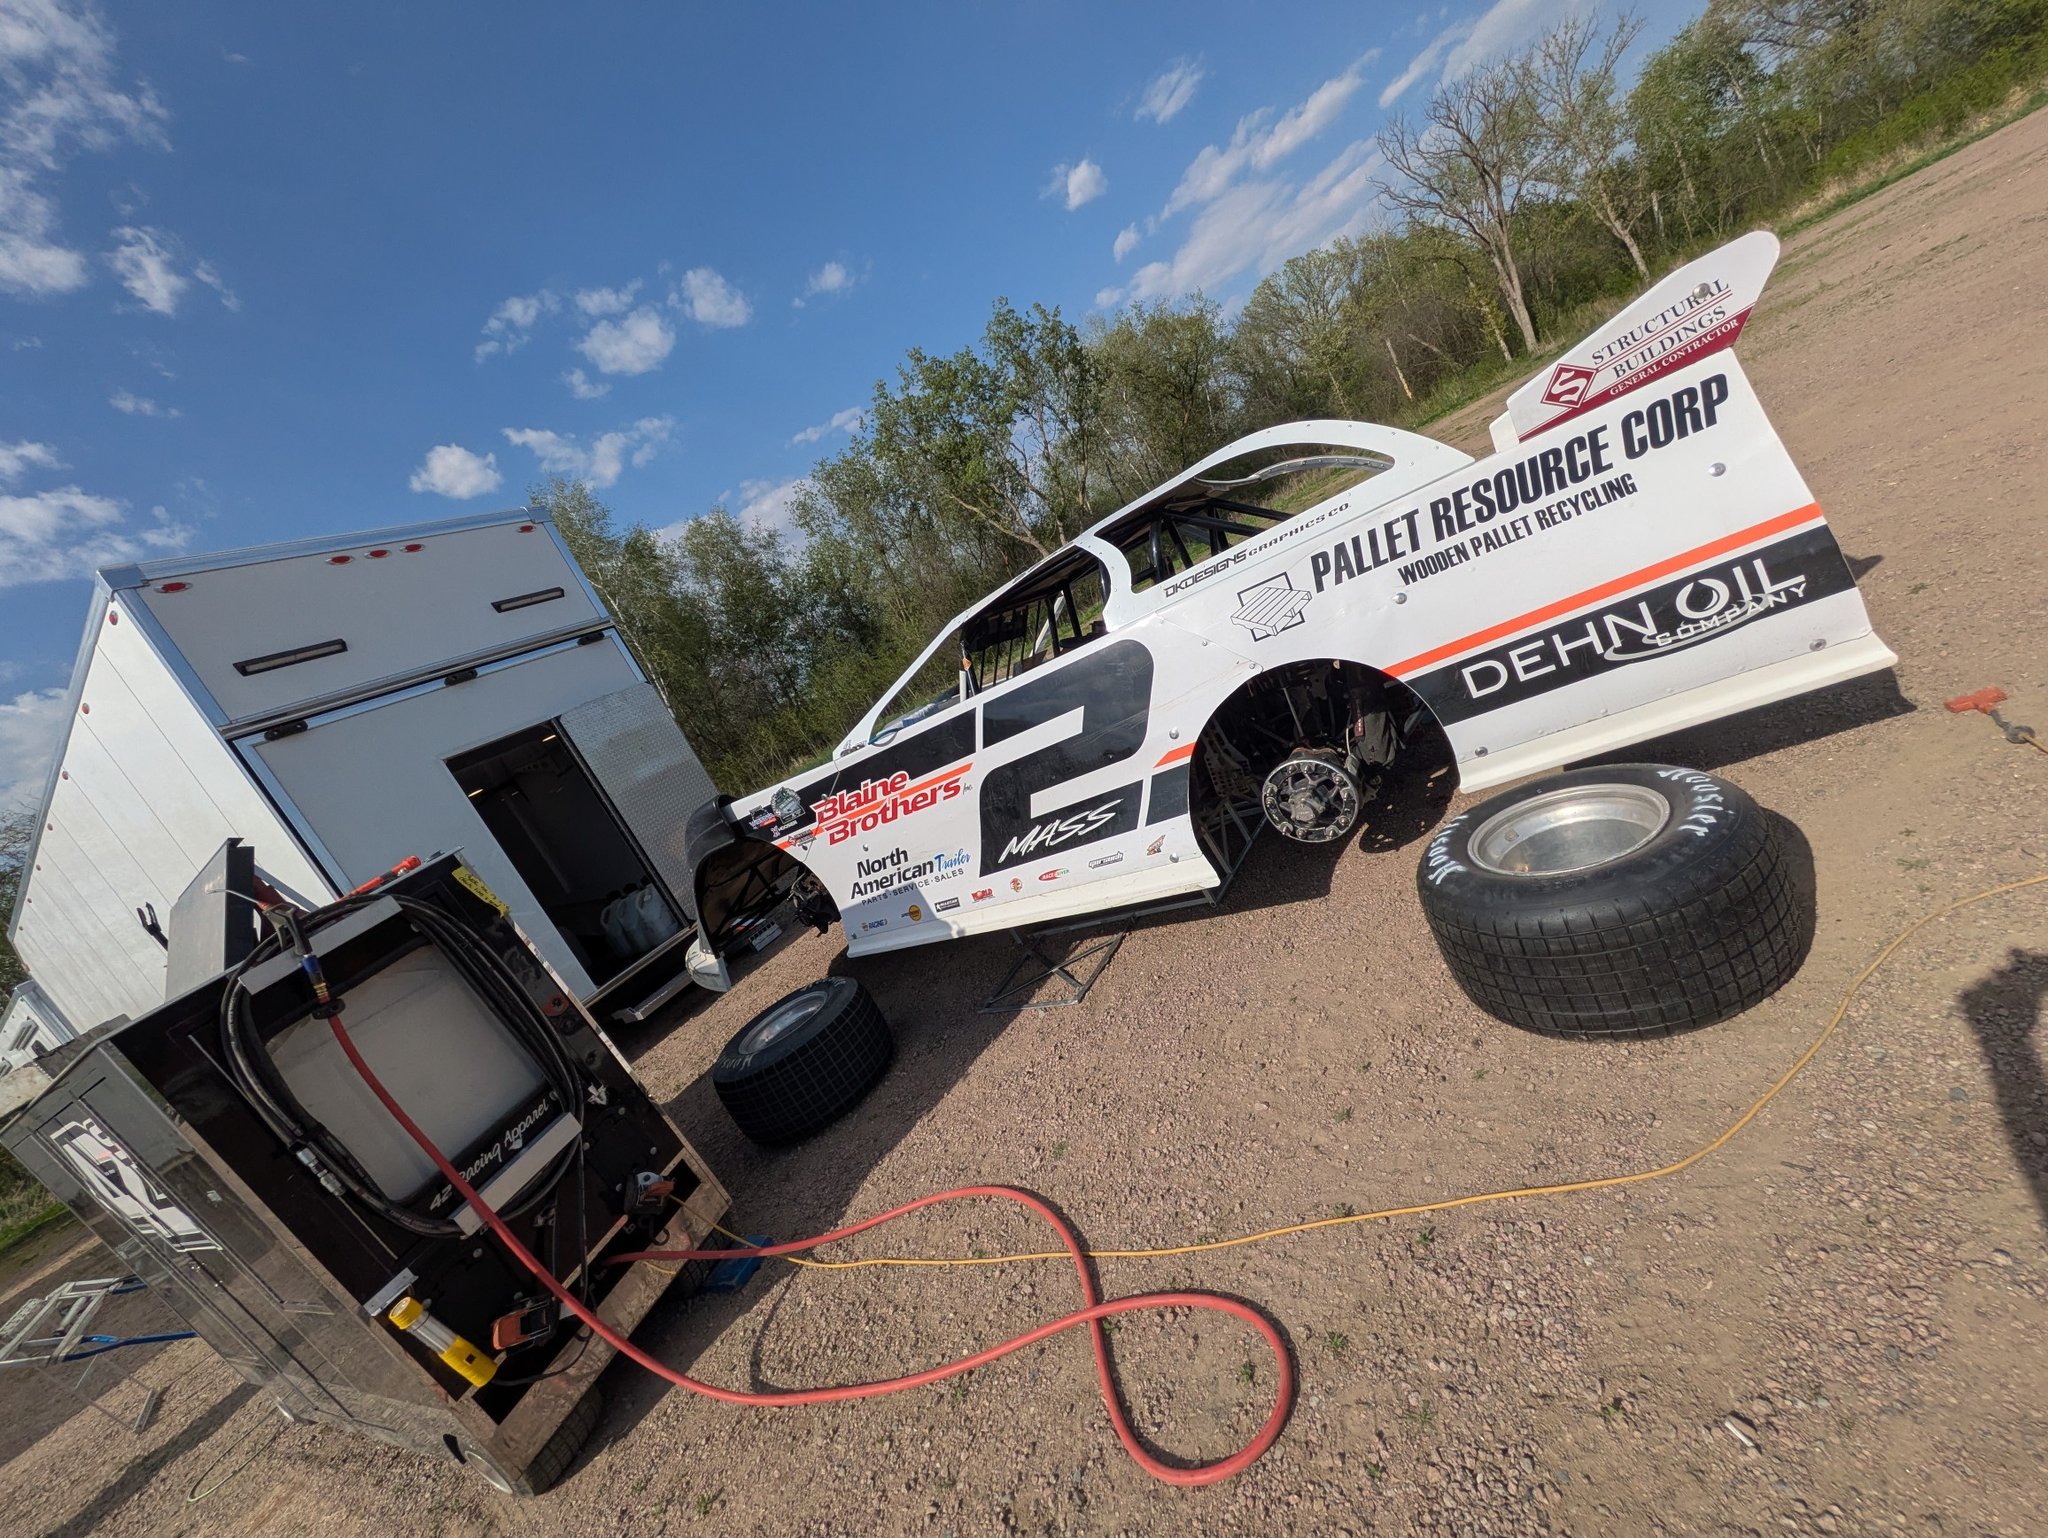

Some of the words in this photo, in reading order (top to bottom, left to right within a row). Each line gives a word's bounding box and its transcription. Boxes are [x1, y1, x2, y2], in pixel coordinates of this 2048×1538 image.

[1592, 278, 1729, 365] STRUCTURAL
[1612, 305, 1727, 379] BUILDINGS
[1609, 365, 1661, 395] GENERAL
[1661, 318, 1739, 367] CONTRACTOR
[1310, 508, 1421, 593] PALLET
[1429, 424, 1613, 542] RESOURCE
[1621, 373, 1729, 460] CORP
[1249, 515, 1326, 556] GRAPHICS
[1397, 535, 1471, 586] WOODEN
[1472, 514, 1534, 558] PALLET
[1537, 473, 1638, 531] RECYCLING
[1461, 601, 1658, 699] DEHN
[1675, 558, 1806, 619] OIL
[1655, 582, 1807, 648] COMPANY
[811, 772, 909, 825] Blaine
[824, 778, 962, 846] Brothers
[998, 799, 1124, 864] MASS
[1656, 767, 1737, 838] Hoosier
[851, 859, 933, 899] American
[934, 849, 971, 872] Trailer
[856, 847, 909, 878] North
[503, 1099, 549, 1148] Apparel
